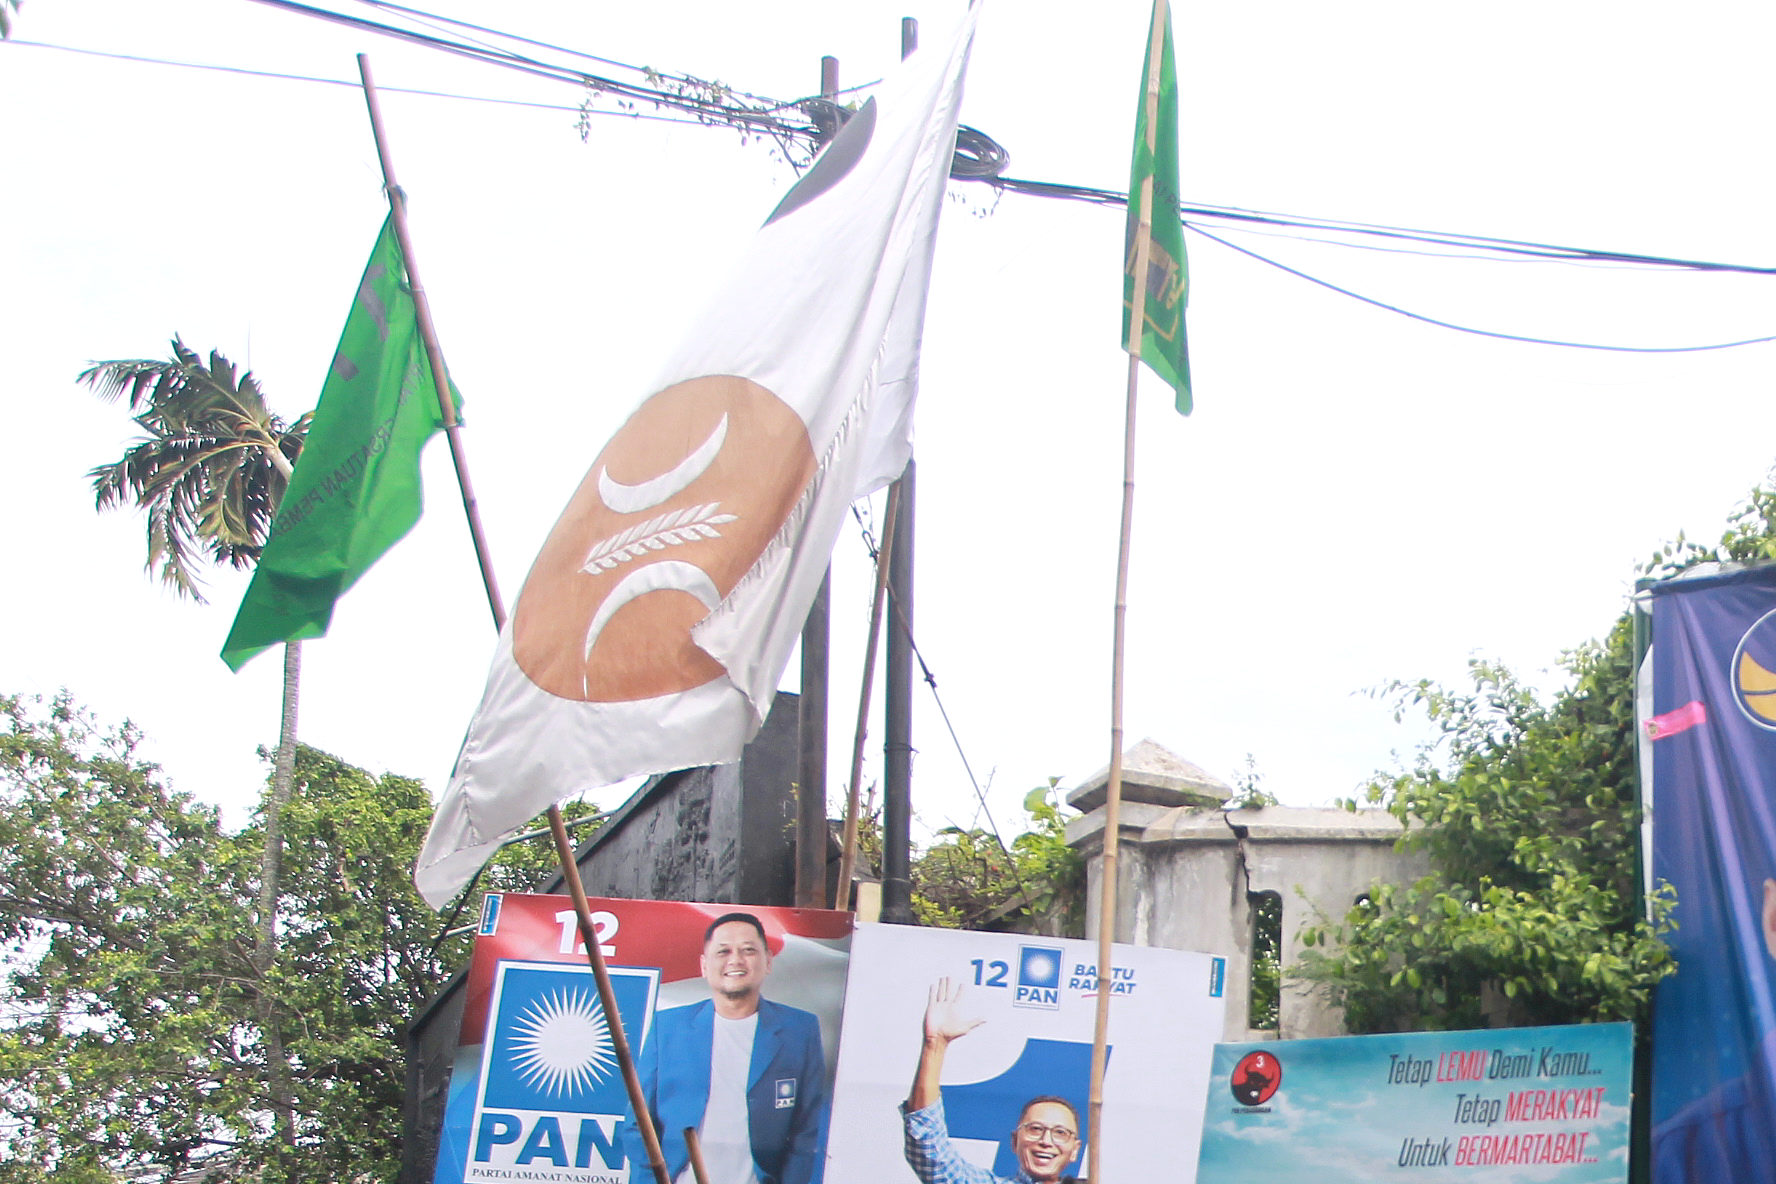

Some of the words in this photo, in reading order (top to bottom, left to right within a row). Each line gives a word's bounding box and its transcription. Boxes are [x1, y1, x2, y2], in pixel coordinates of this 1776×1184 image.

[555, 910, 620, 957] 12
[971, 958, 1009, 988] 12
[1074, 964, 1135, 980] BATU
[1016, 987, 1058, 1004] PAN
[1256, 1055, 1264, 1068] 3
[1387, 1054, 1433, 1088] Tetap
[1436, 1050, 1489, 1082] LEMU
[1488, 1048, 1536, 1080] Demi
[1536, 1046, 1602, 1078] Kamu...
[1454, 1094, 1502, 1127] Tetap
[1504, 1087, 1606, 1122] MERAKYAT
[474, 1112, 626, 1171] PAN
[1398, 1137, 1452, 1167] Untuk
[1454, 1131, 1598, 1166] BERMARTABAT...
[472, 1168, 512, 1179] PARTAI
[513, 1171, 563, 1182] AMANAT
